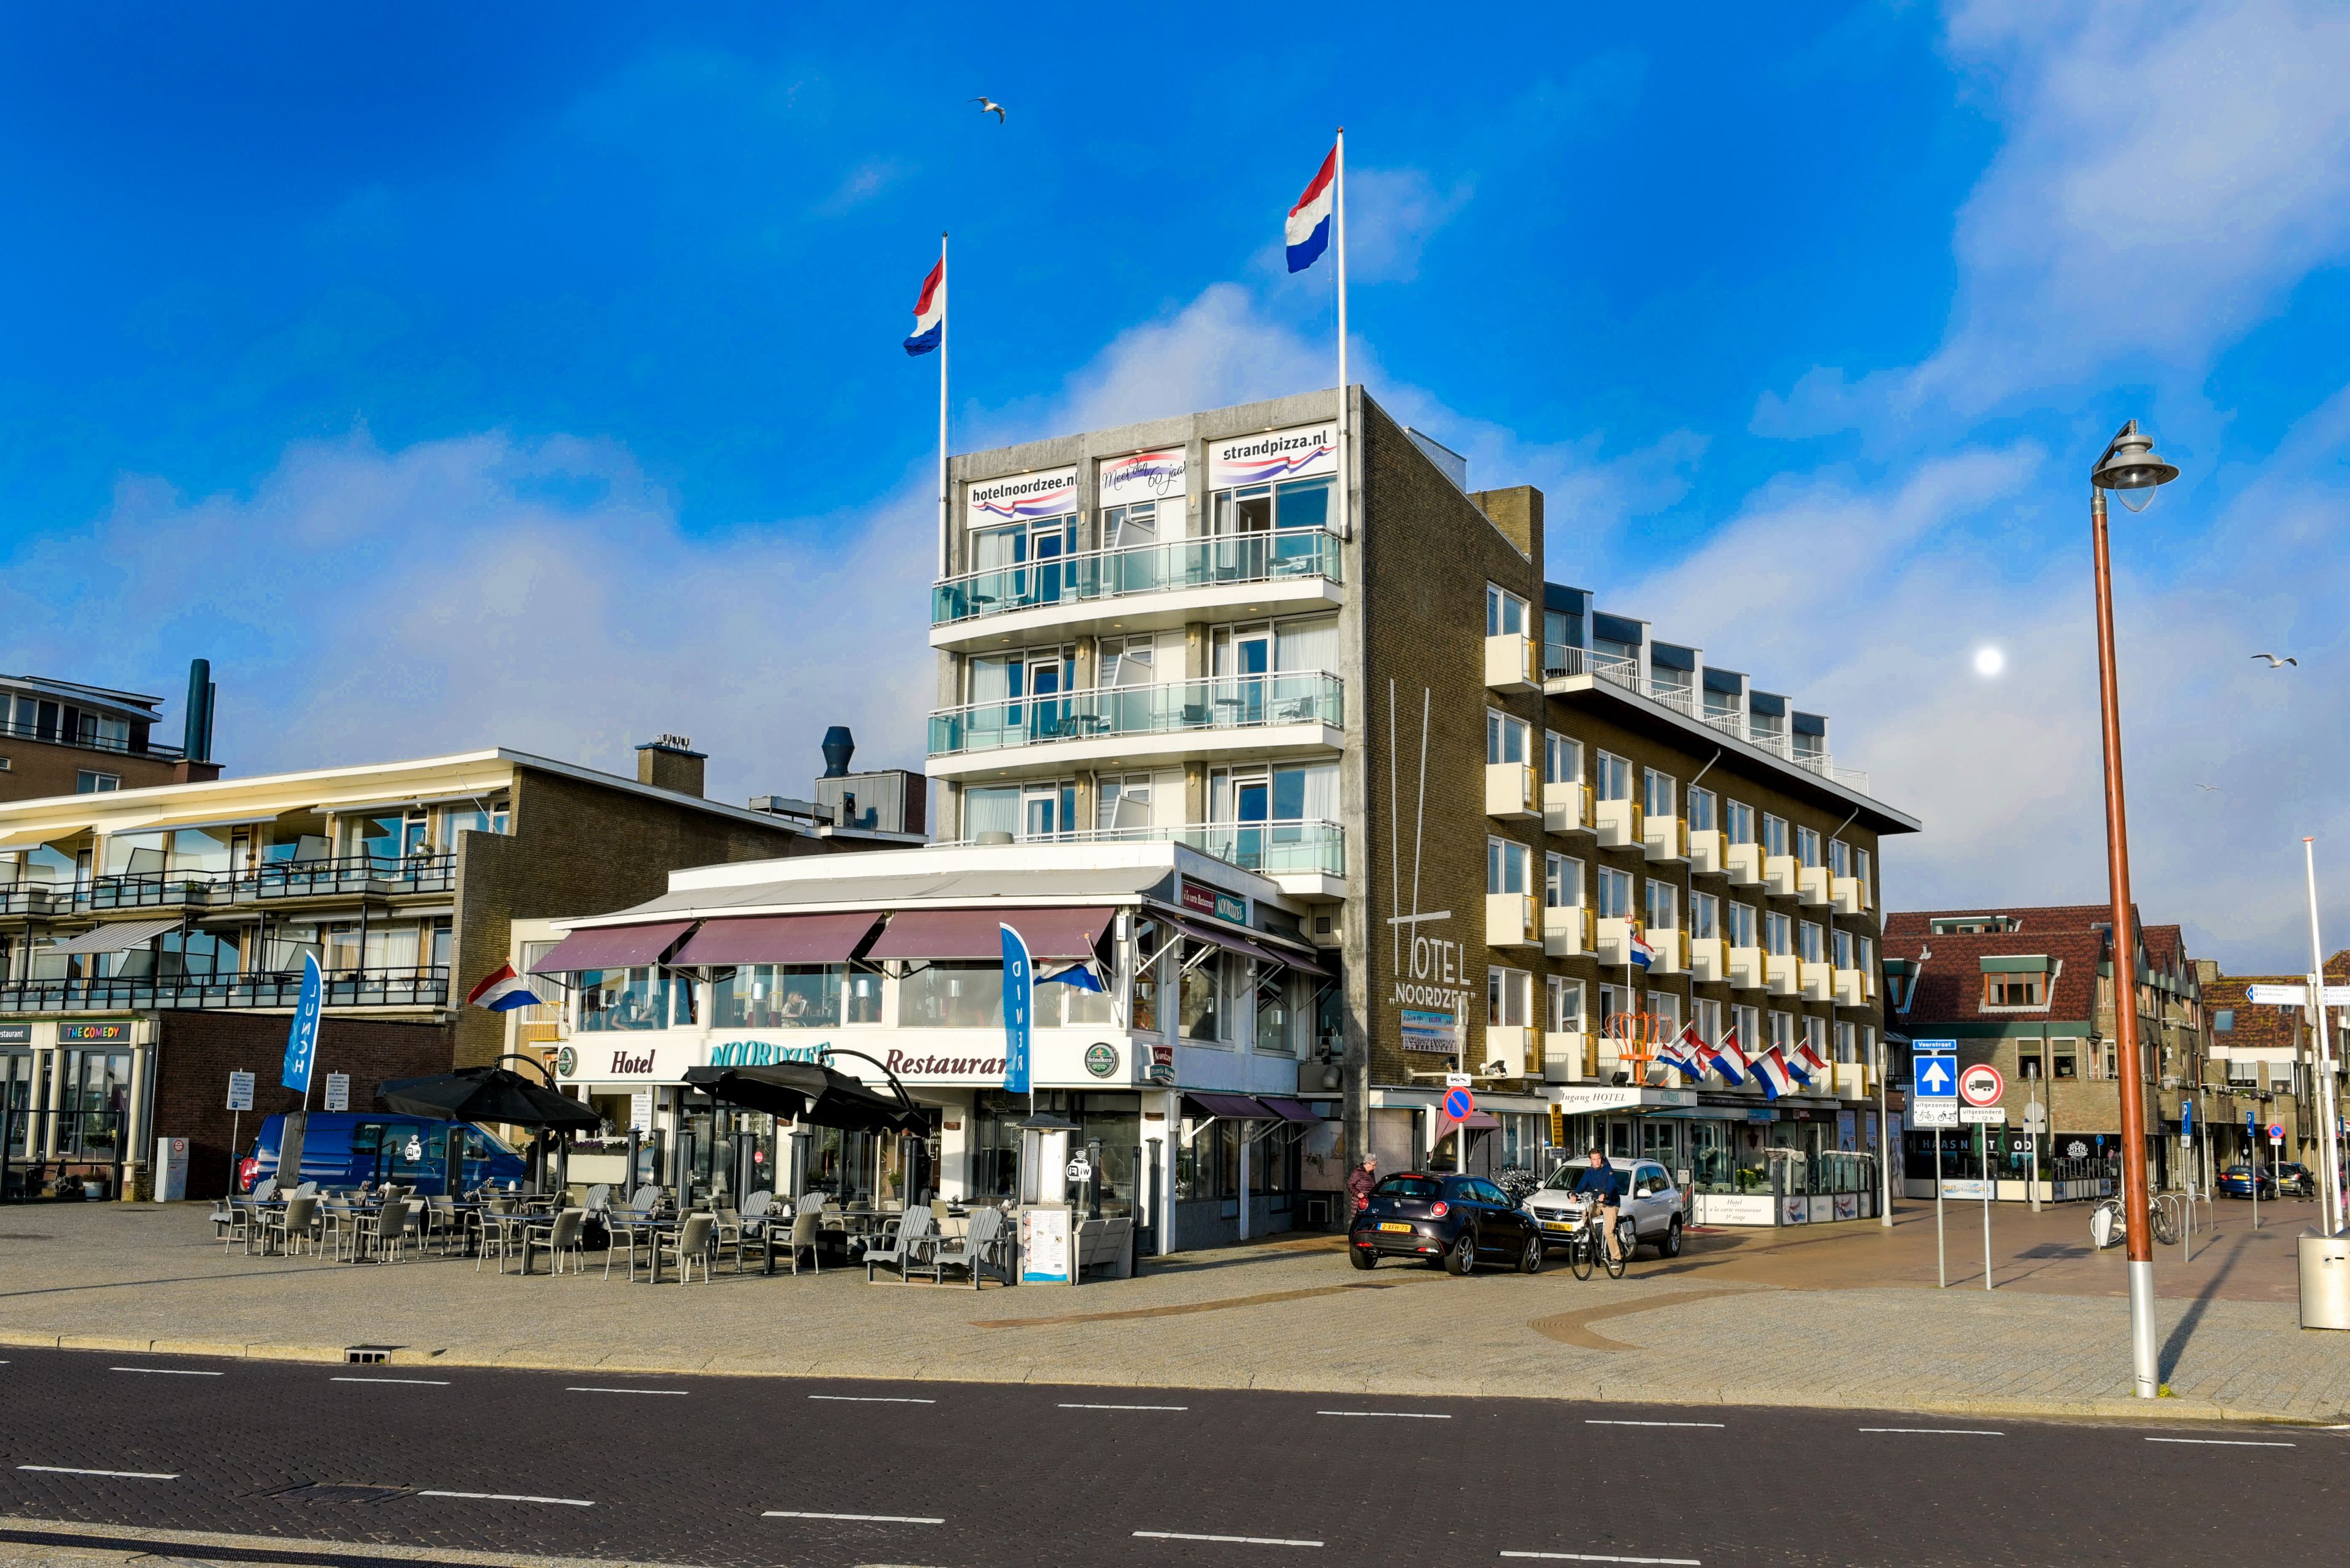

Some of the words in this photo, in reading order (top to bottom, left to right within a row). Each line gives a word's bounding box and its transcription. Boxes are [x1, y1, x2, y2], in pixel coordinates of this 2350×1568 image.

[1223, 430, 1327, 460] strandpizza.nl
[1103, 472, 1132, 491] Meer
[1129, 458, 1149, 476] dan
[1147, 466, 1163, 488] 60
[973, 472, 1077, 502] hotelnoordzee.nl
[1217, 898, 1244, 920] NOORDZEE
[67, 1027, 83, 1039] THE
[83, 1026, 120, 1039] COMEDY
[610, 1049, 656, 1073] Hotel
[1561, 1092, 1590, 1103] Ingang
[1592, 1093, 1627, 1102] HOTEL
[1554, 1105, 1559, 1115] P
